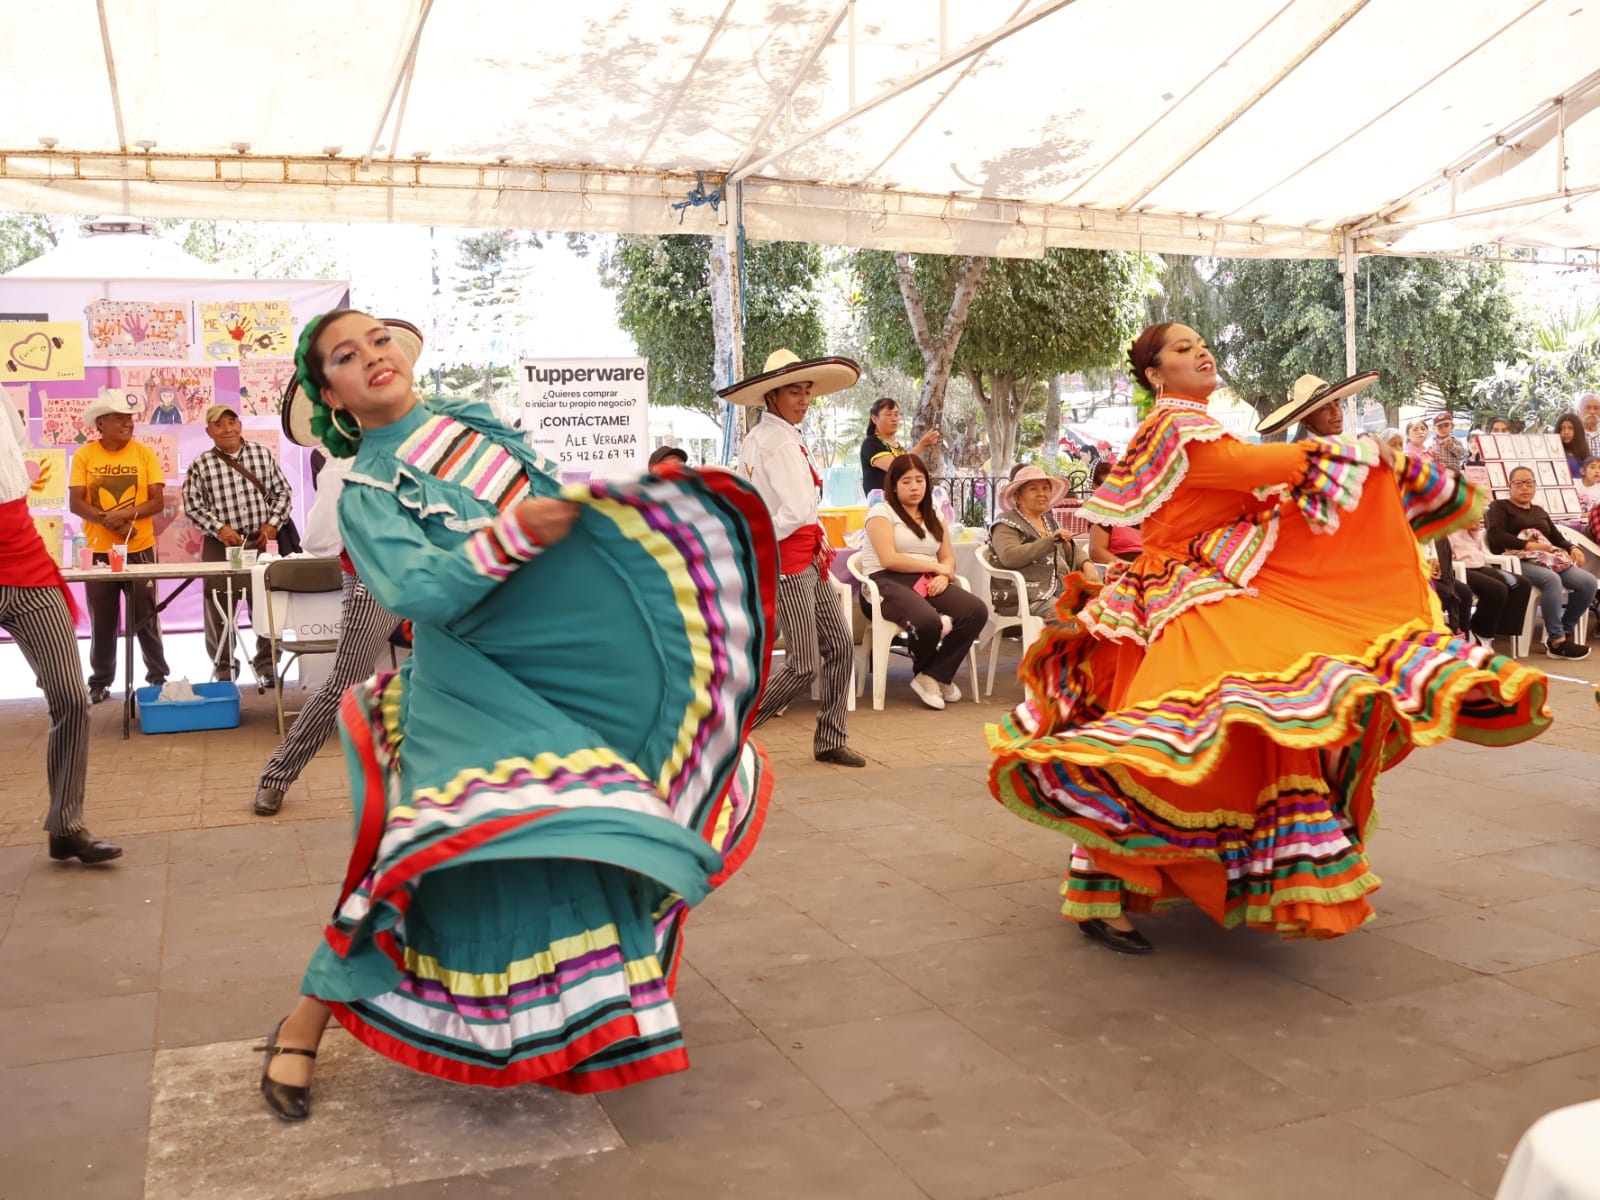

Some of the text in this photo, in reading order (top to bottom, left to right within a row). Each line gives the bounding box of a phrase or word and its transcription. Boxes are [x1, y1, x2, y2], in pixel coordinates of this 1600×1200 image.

[264, 302, 279, 310] NO
[524, 365, 645, 386] Tupperware
[542, 390, 618, 399] ¿Quieres comprar
[532, 400, 557, 408] iniciar
[559, 400, 568, 408] tu
[569, 400, 597, 409] propio
[598, 399, 637, 408] negocio?
[540, 413, 630, 429] ¡CONTÁCTAME!
[565, 433, 637, 447] ALE VERGARA
[560, 451, 573, 462] 55
[576, 451, 590, 461] 42
[592, 450, 604, 460] 62
[607, 449, 620, 459] 67
[91, 464, 138, 475] adidas
